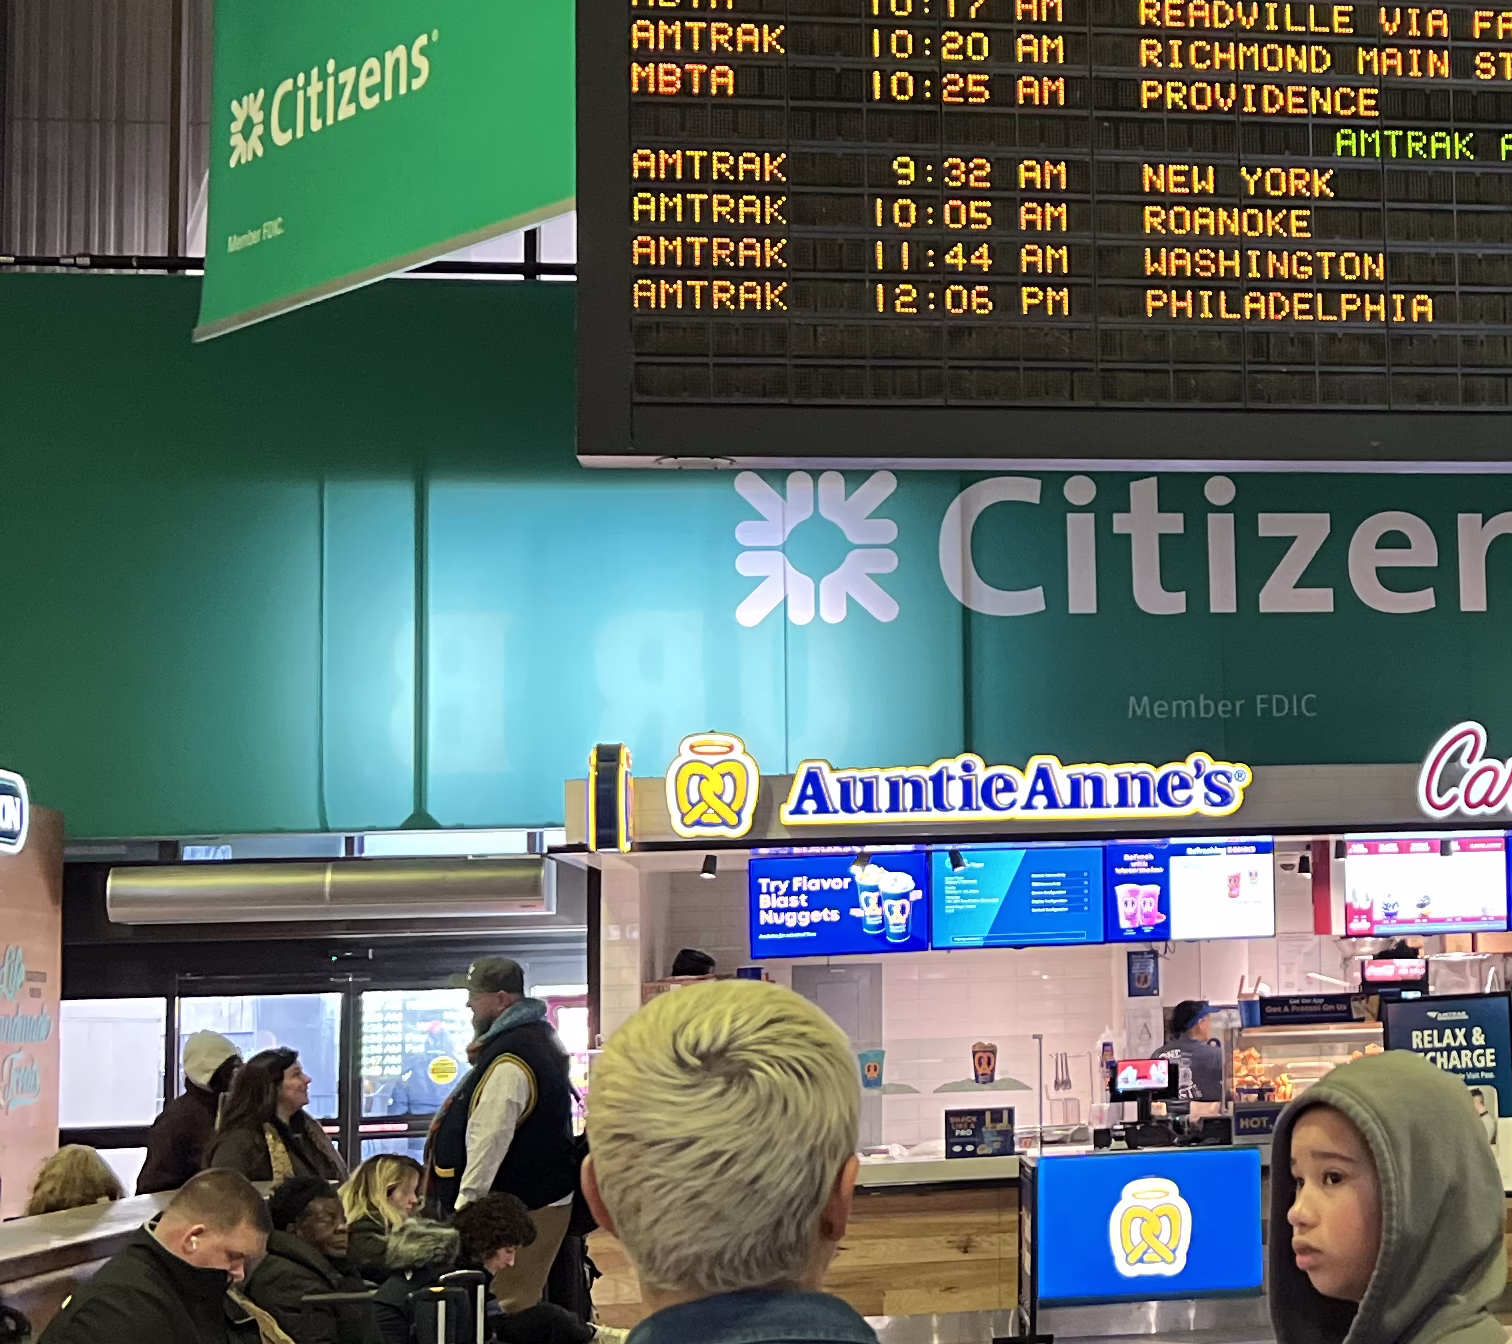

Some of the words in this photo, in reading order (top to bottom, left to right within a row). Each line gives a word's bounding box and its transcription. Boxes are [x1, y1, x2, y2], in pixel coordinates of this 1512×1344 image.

[1336, 130, 1476, 161] AMTRAK
[633, 193, 788, 226] AMTRAK
[875, 200, 993, 231] 10:05
[1019, 203, 1068, 233] AM
[1143, 206, 1312, 239] ROANOKE
[1127, 694, 1242, 720] Member
[1255, 693, 1318, 719] FDIC
[758, 877, 791, 896] Try
[758, 892, 809, 909] Blast
[758, 907, 841, 928] Nuggets
[1411, 1027, 1468, 1050] RELAX
[1471, 1026, 1486, 1046] &
